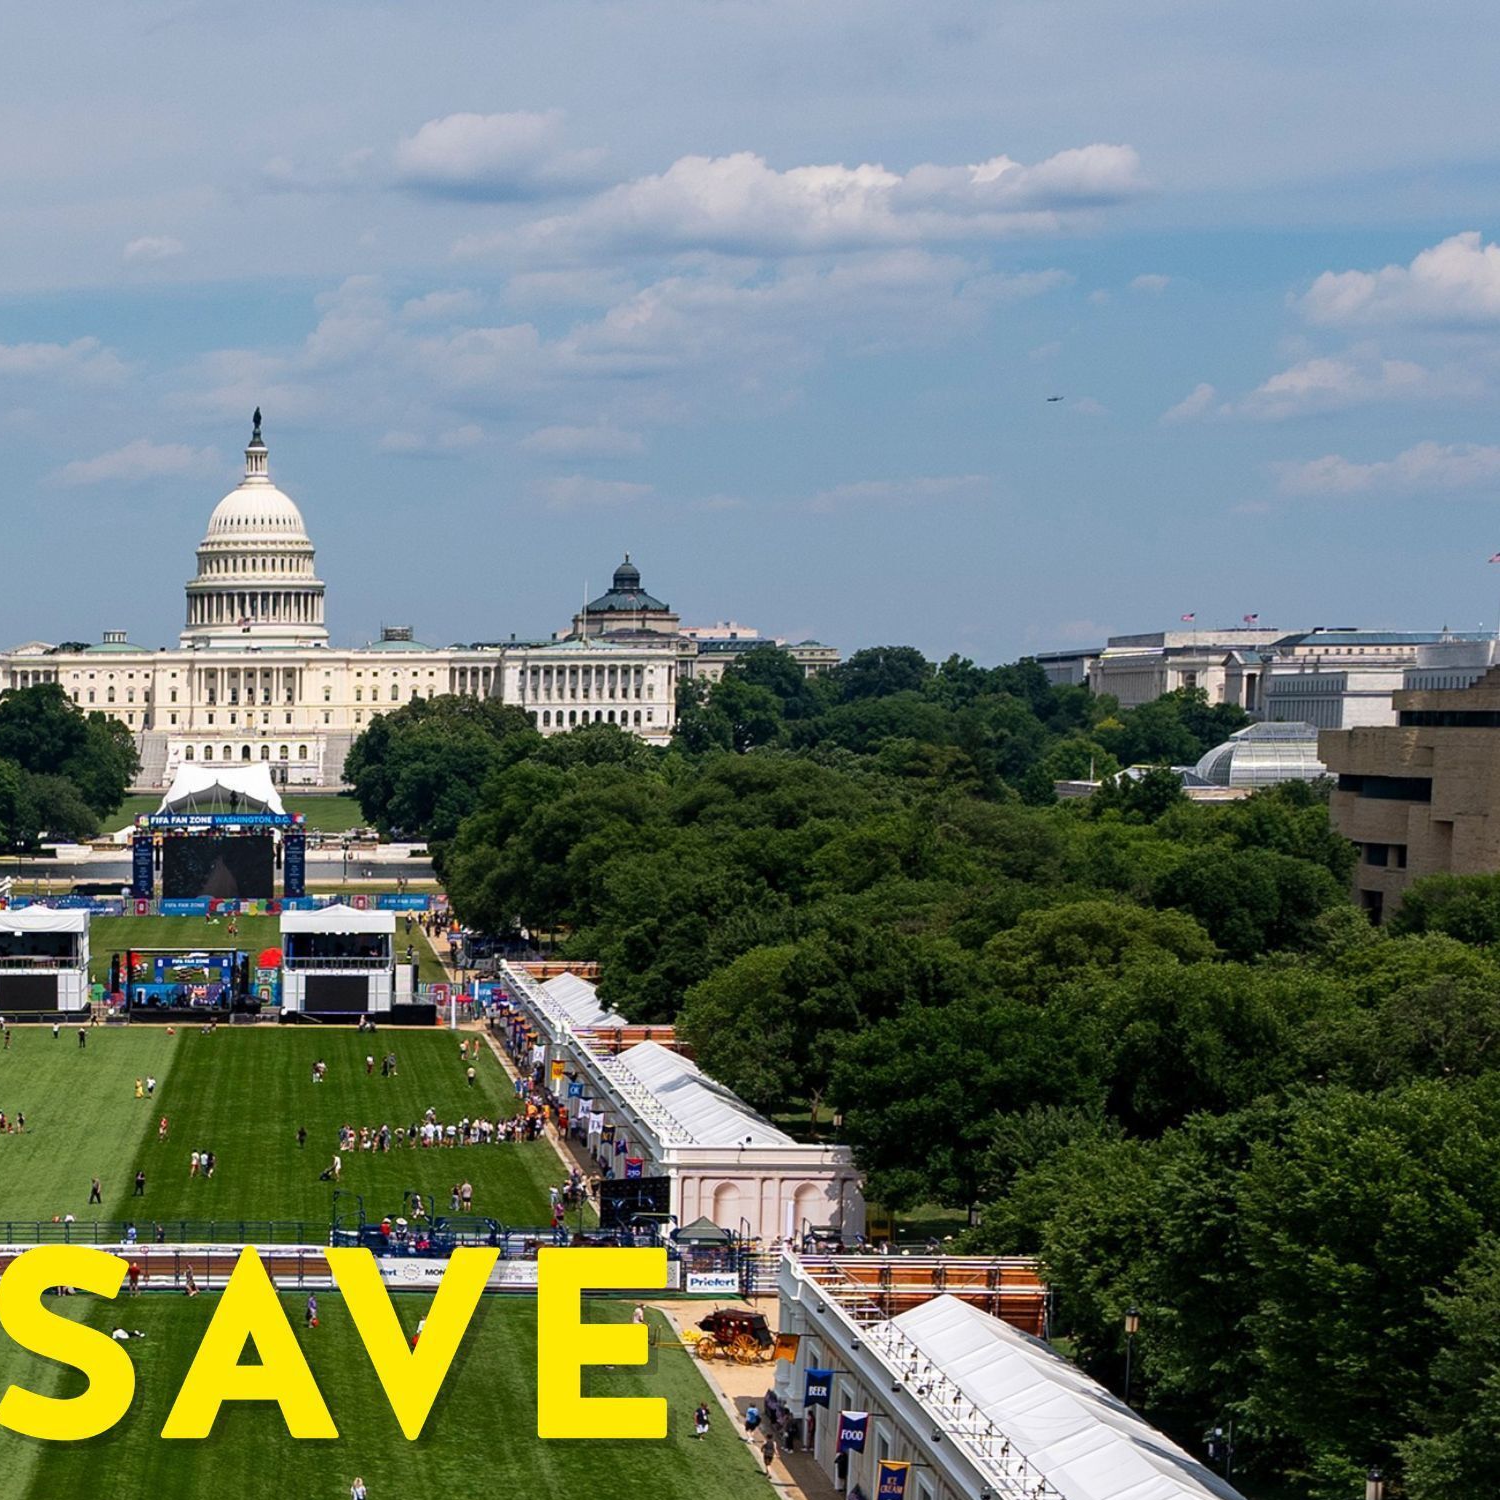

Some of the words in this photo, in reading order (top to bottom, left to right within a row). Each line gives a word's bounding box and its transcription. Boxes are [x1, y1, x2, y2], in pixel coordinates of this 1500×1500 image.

[151, 816, 169, 825] FIFA
[171, 816, 188, 825] FAN
[189, 816, 212, 825] ZONE
[275, 816, 291, 824] D.C.
[627, 1170, 641, 1178] 250
[691, 1277, 736, 1287] Priefert
[808, 1386, 827, 1397] BEER
[841, 1429, 864, 1441] FOOD
